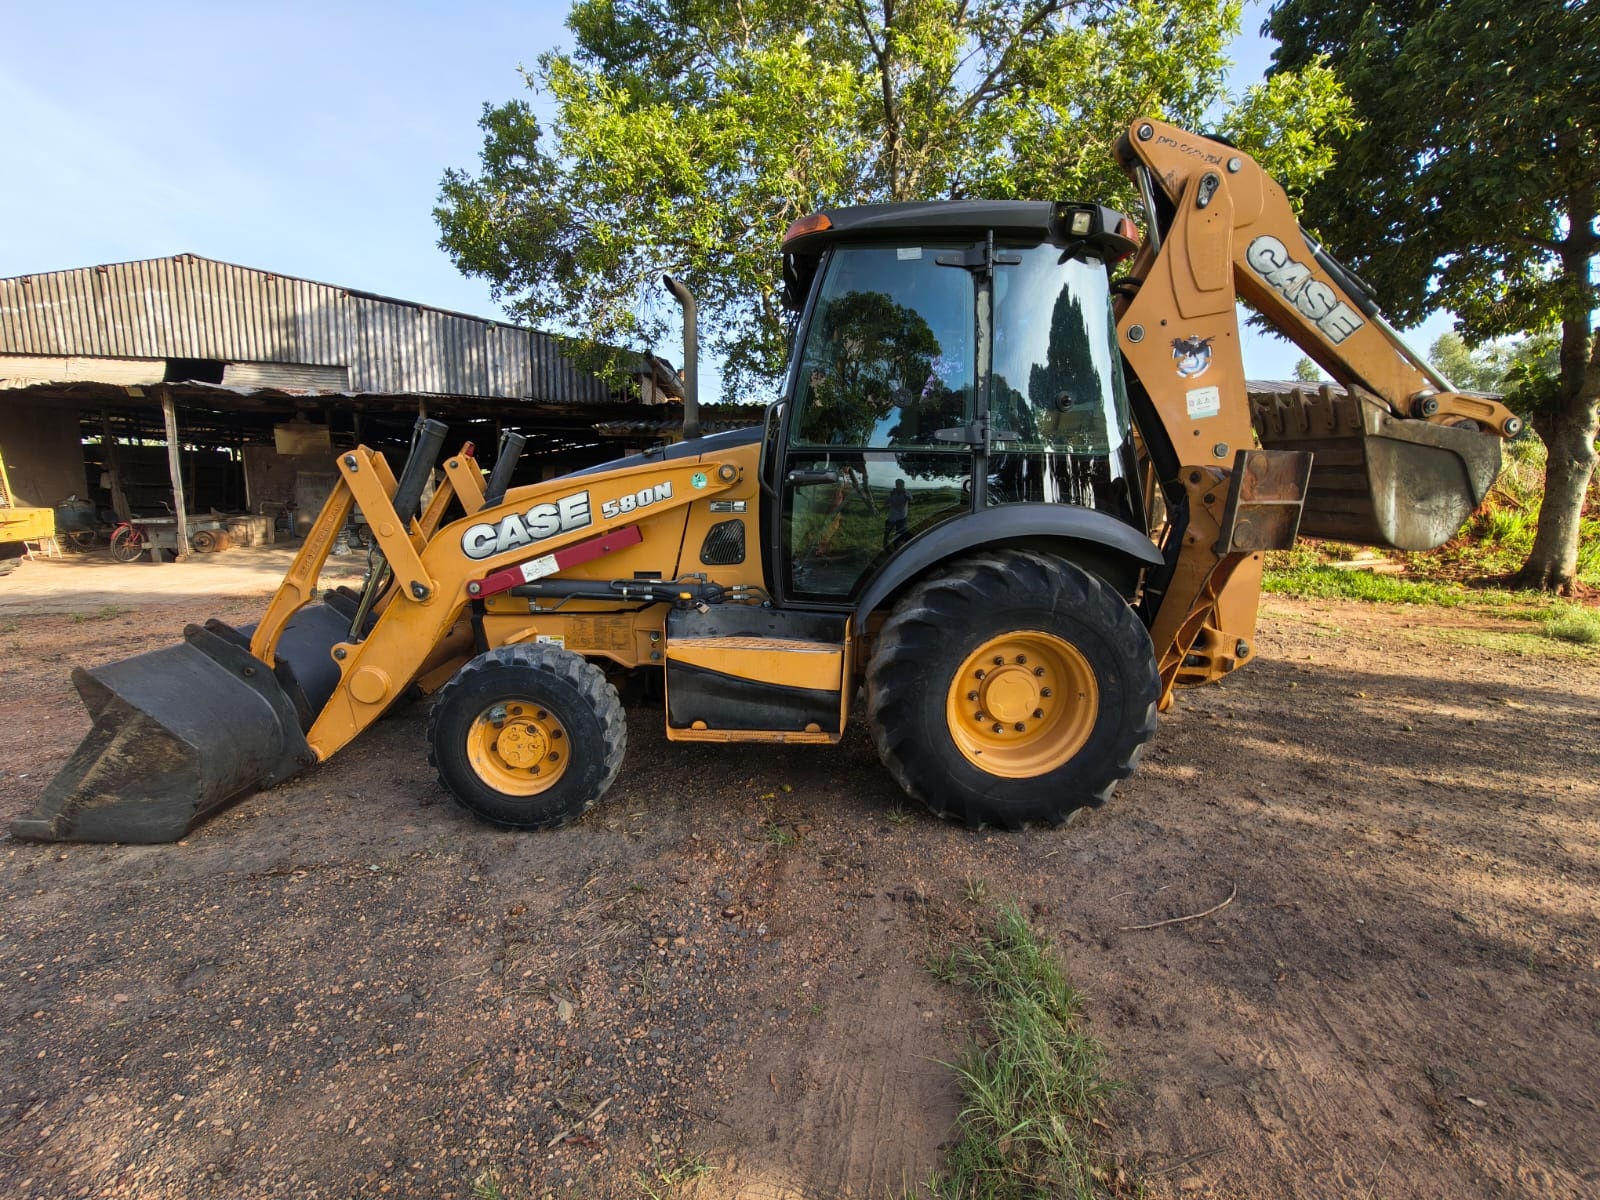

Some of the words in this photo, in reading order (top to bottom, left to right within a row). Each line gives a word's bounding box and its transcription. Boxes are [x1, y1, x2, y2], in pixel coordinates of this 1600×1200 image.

[1245, 235, 1365, 346] CASE
[461, 490, 593, 561] CASE
[601, 481, 674, 519] 580N
